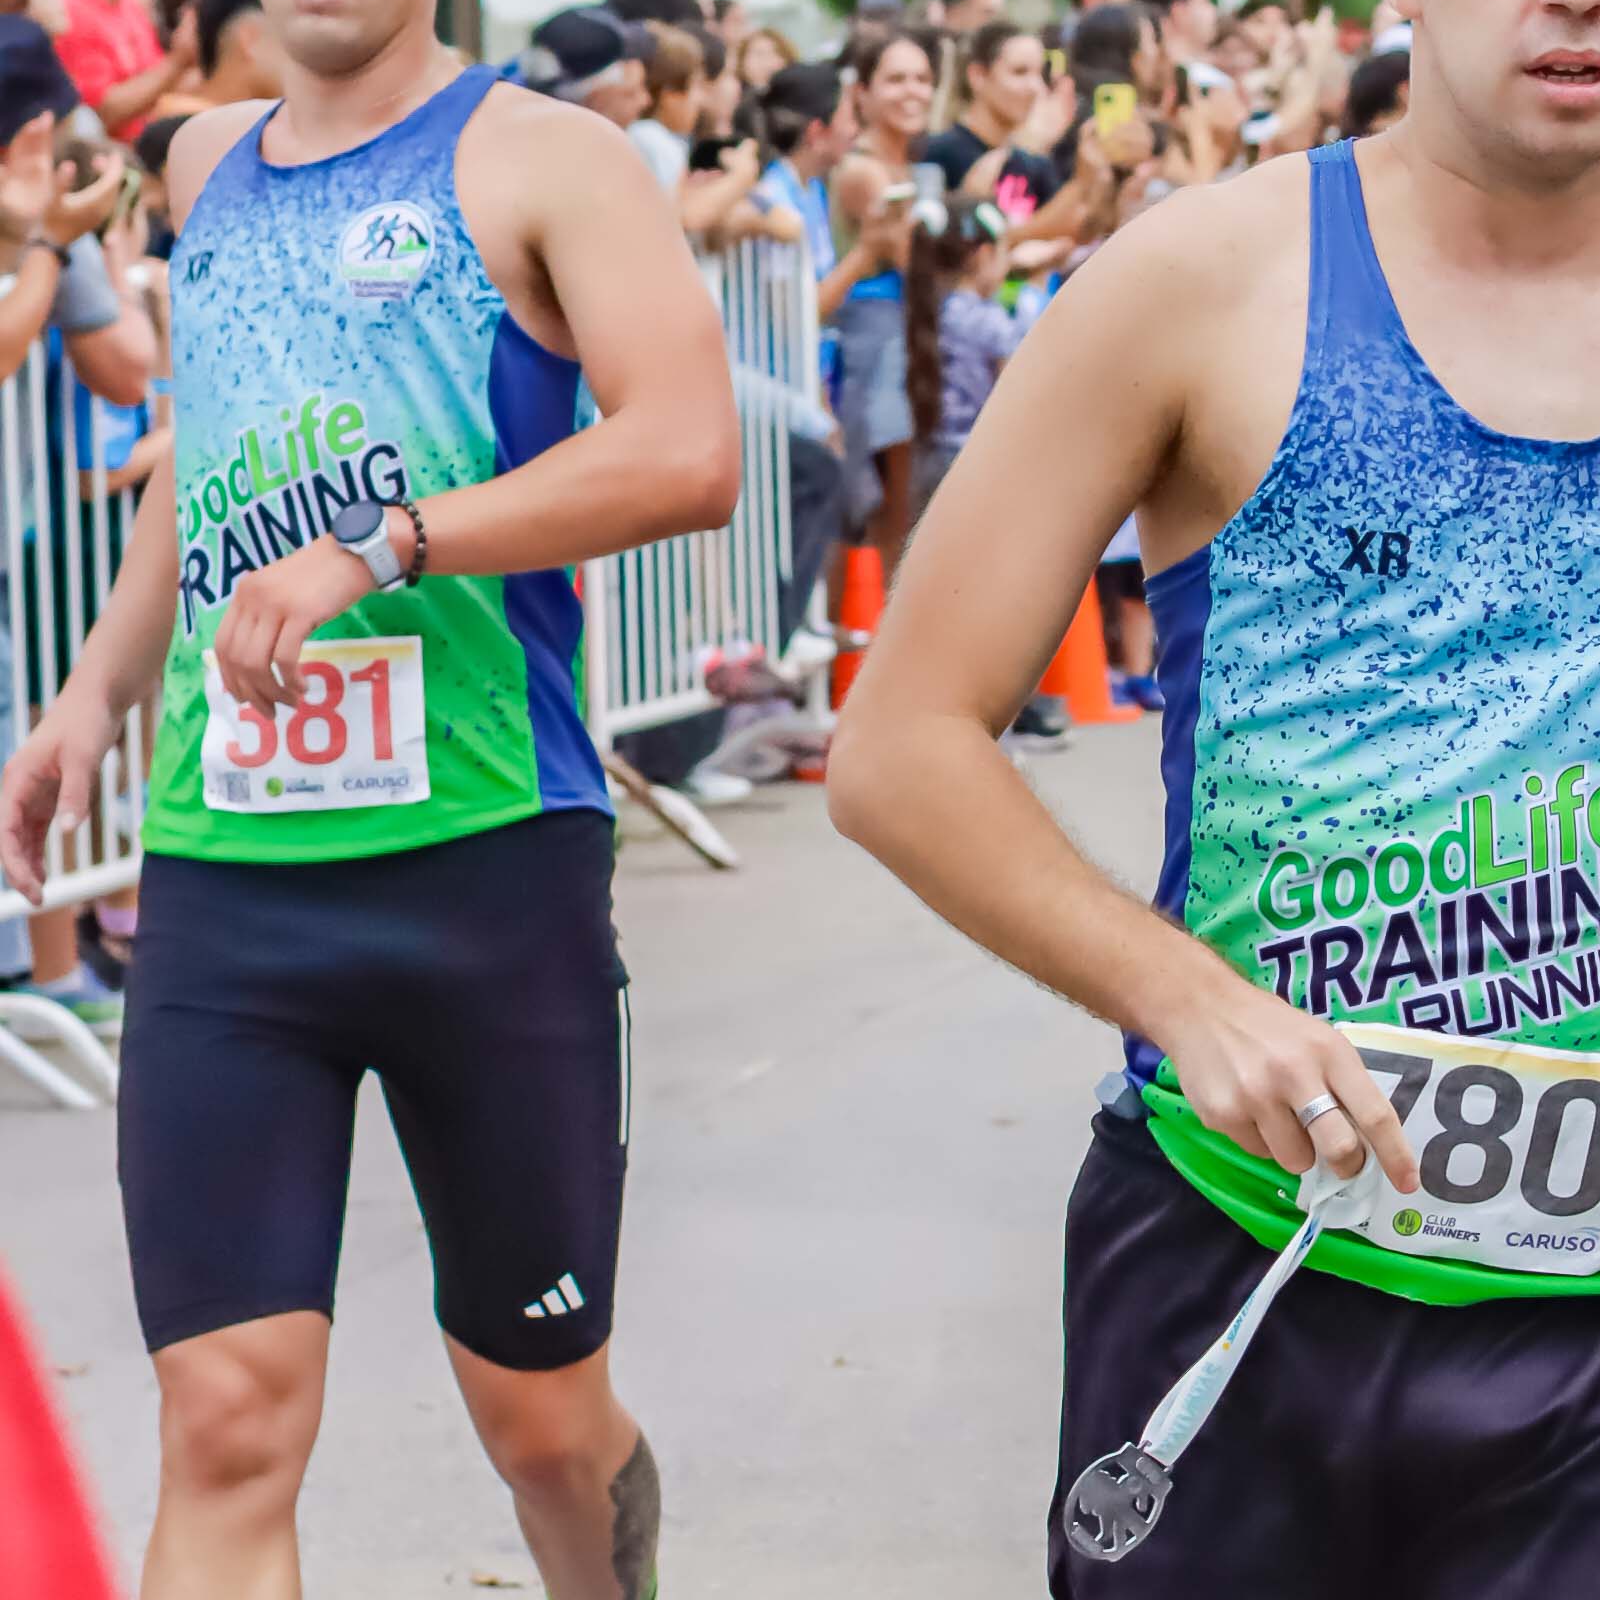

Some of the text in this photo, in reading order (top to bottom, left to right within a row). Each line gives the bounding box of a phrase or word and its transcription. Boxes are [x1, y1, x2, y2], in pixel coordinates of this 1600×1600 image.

[178, 396, 366, 543] oodLife
[180, 444, 407, 635] RAINING
[1339, 525, 1411, 578] XR
[1422, 1225, 1481, 1243] RUNNER'S
[1426, 1214, 1457, 1228] CLUB
[1506, 1230, 1597, 1253] CARUSO
